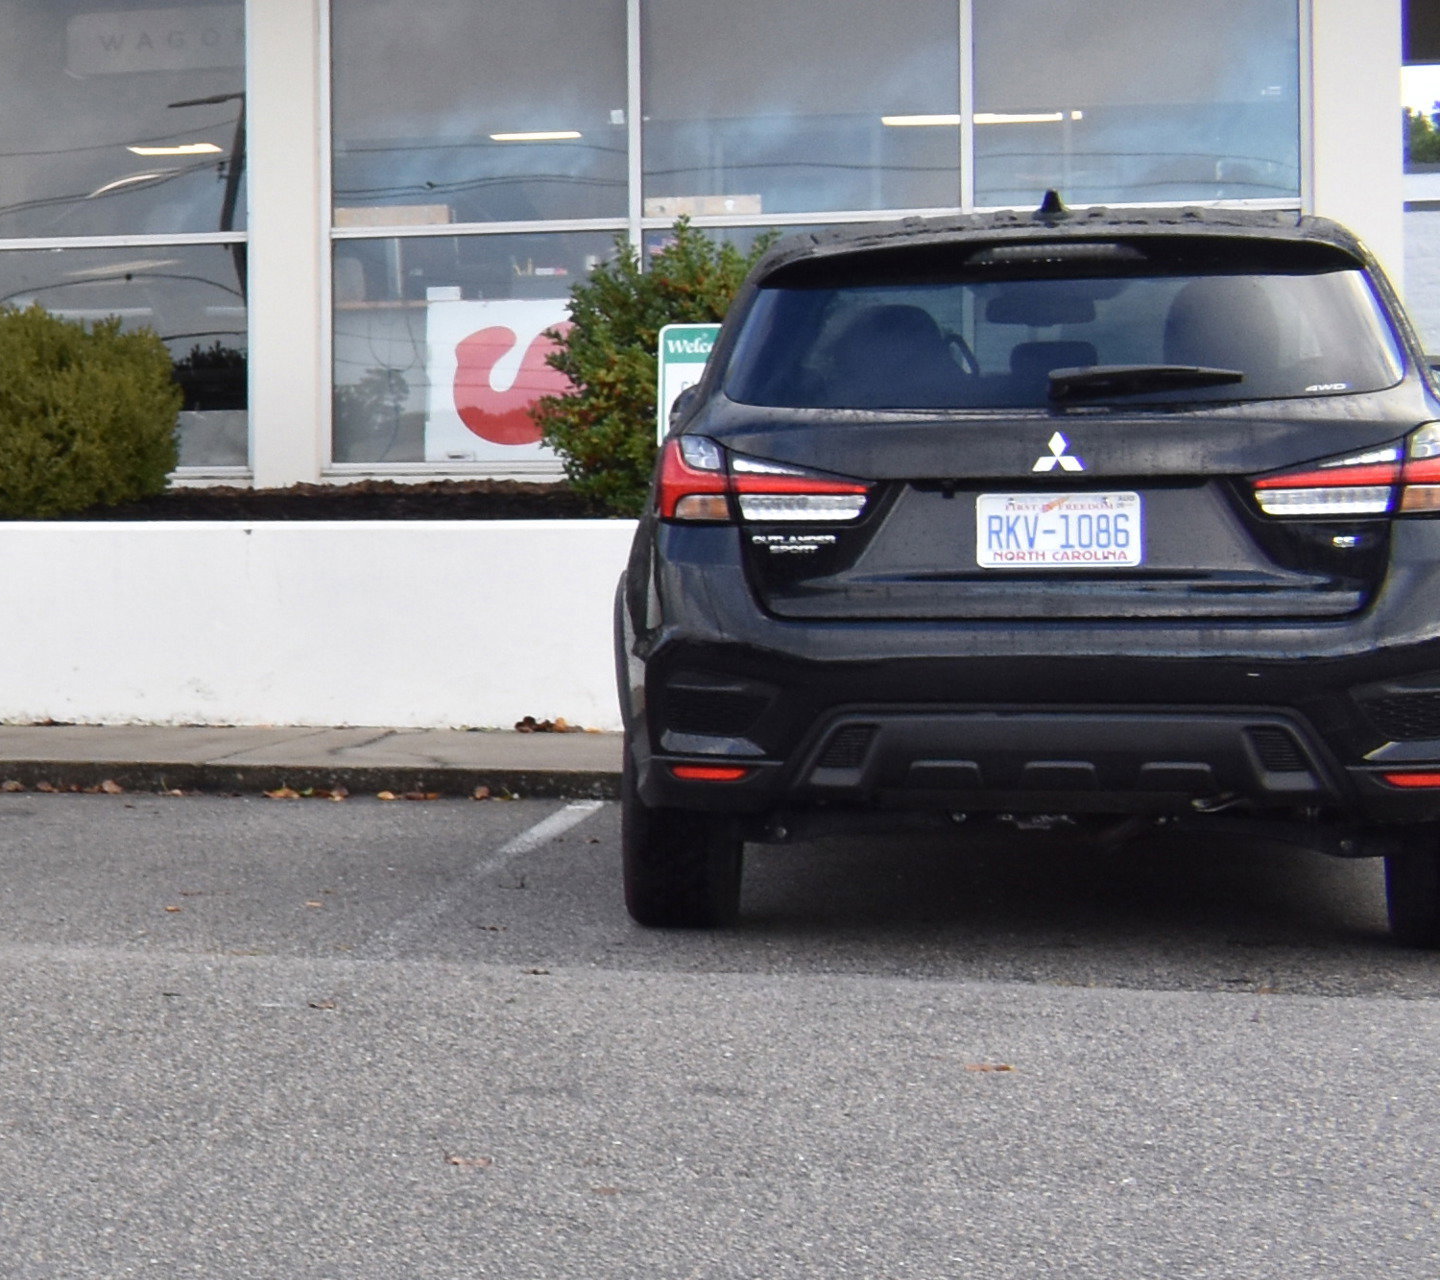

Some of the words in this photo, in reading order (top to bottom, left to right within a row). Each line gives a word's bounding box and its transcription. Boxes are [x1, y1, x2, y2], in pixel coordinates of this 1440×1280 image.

[98, 26, 244, 53] WAGO
[988, 513, 1130, 549] RKV-1086
[993, 551, 1046, 561] NORTH
[1052, 550, 1129, 561] CAROLINA
